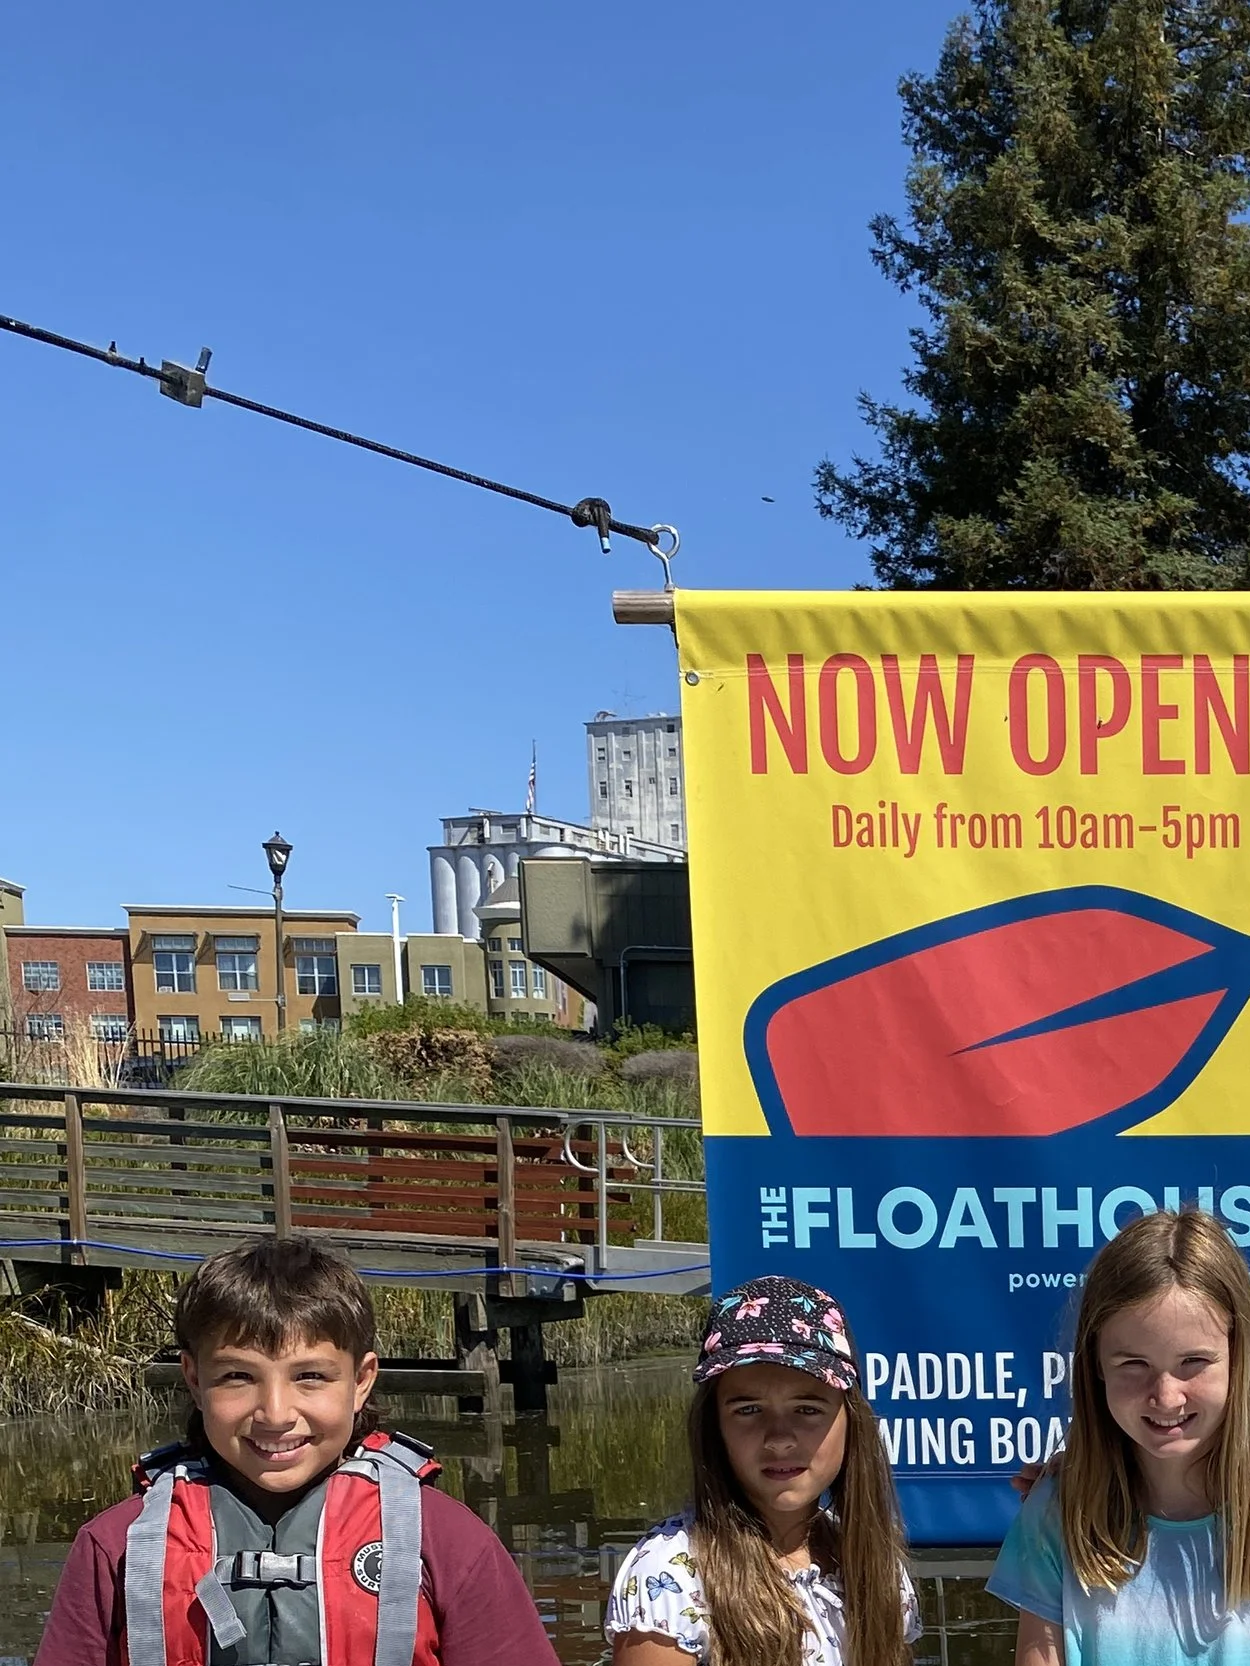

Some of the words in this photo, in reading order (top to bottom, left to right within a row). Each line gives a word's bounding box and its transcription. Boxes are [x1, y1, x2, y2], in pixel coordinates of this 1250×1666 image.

[745, 652, 976, 775] NOW
[831, 800, 922, 859] Daily
[933, 802, 1023, 849] from
[760, 1186, 789, 1249] THE
[865, 1352, 1028, 1408] PADDLE,
[989, 1416, 1073, 1465] BOA
